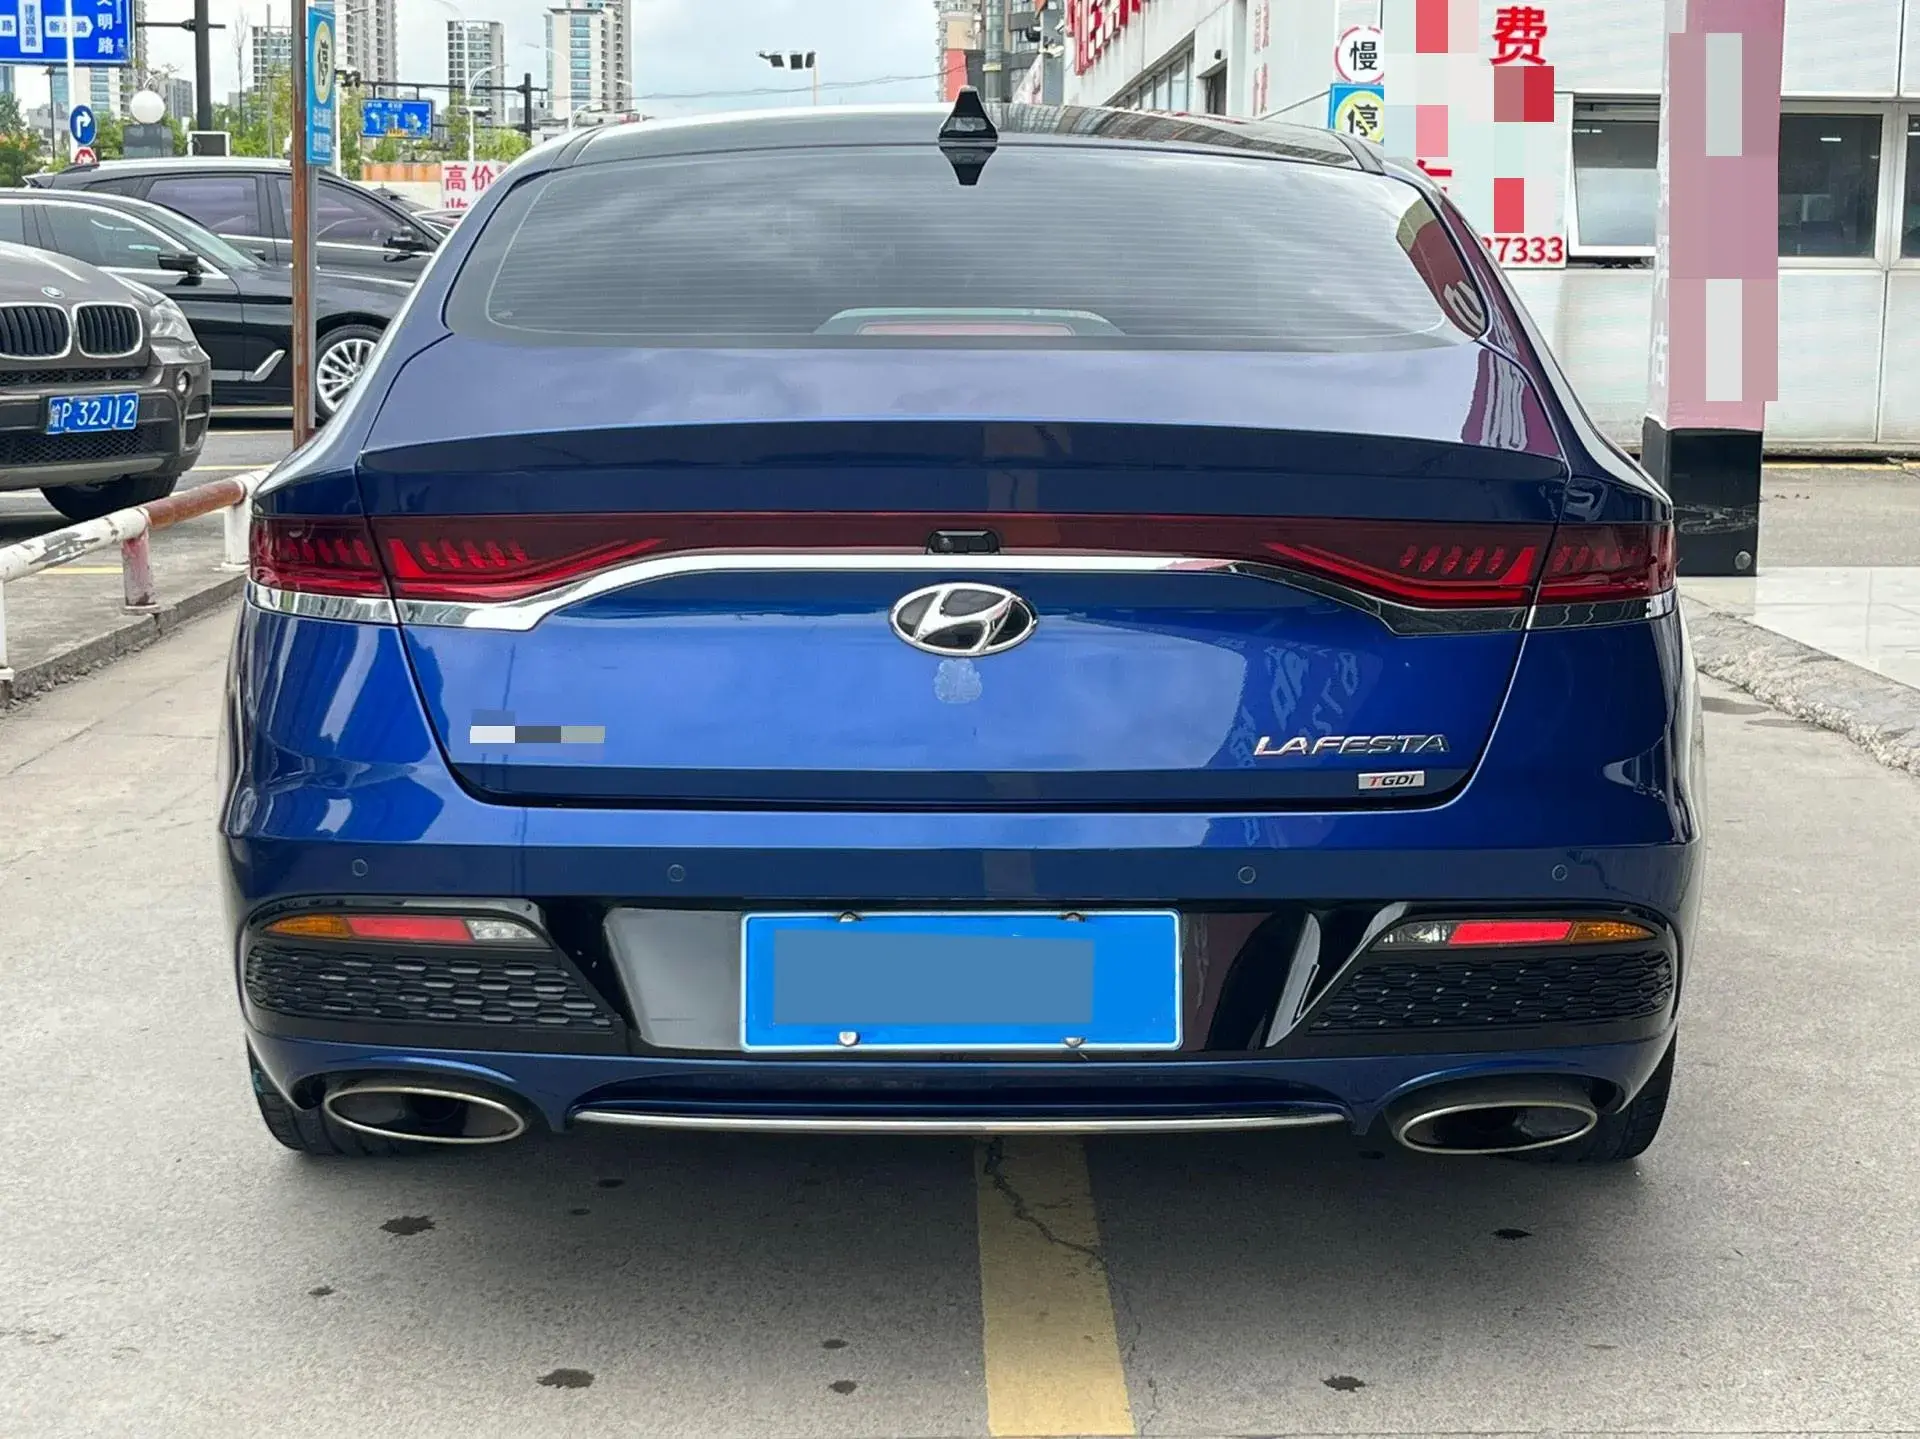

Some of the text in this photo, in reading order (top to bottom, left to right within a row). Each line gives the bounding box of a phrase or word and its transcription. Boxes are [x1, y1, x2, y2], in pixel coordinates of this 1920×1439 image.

[1489, 6, 1547, 65] 费
[1349, 41, 1378, 71] 慢
[1347, 104, 1378, 136] 停
[444, 164, 494, 192] 高价
